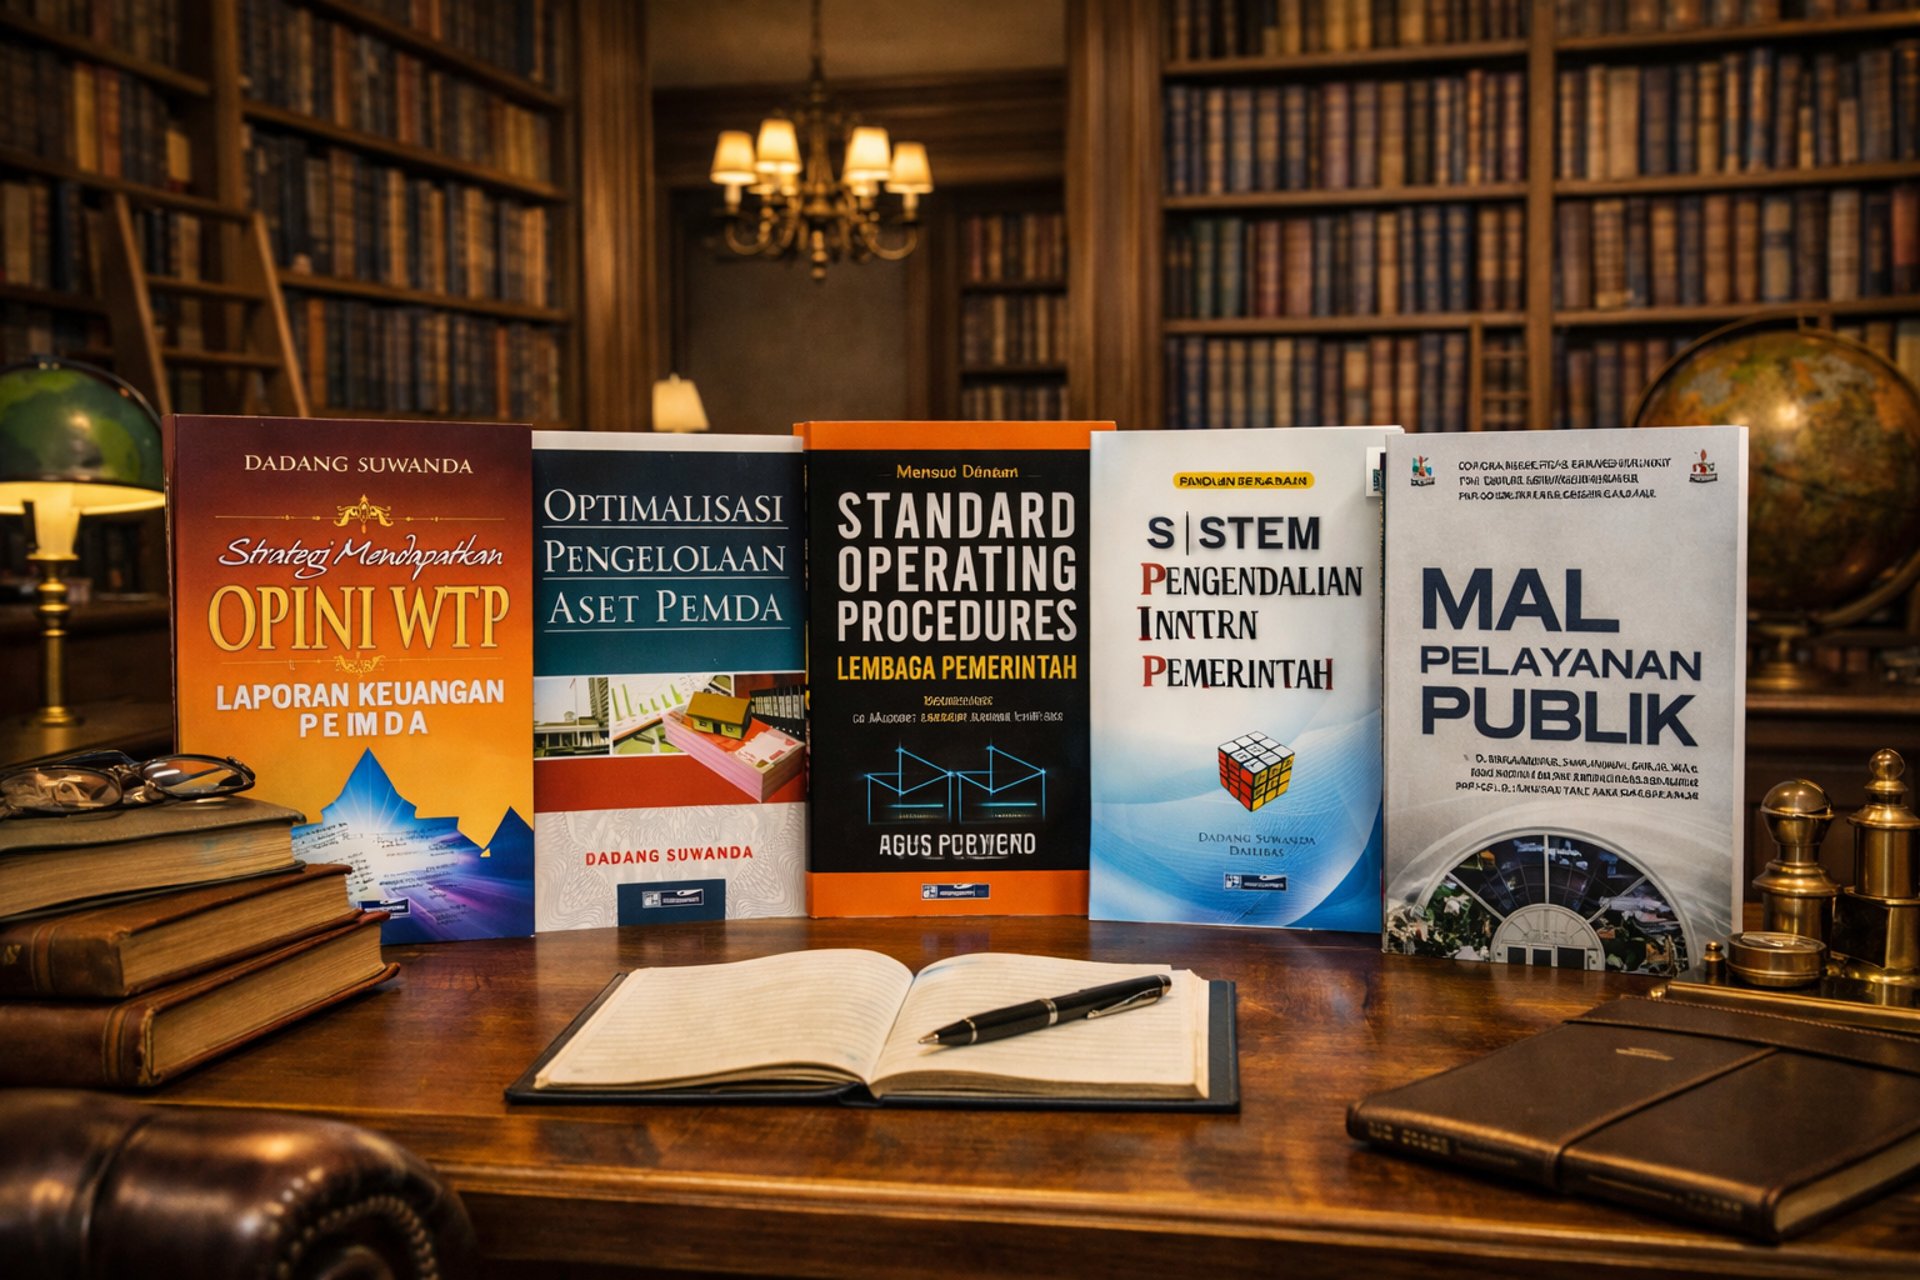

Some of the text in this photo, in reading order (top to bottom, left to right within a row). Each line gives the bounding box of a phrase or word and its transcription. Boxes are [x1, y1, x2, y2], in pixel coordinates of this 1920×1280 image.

[244, 454, 474, 475] DADANG SUWANDA
[544, 488, 784, 523] OPTIMALISASI
[837, 491, 1076, 540] STANDARD
[217, 533, 504, 581] Strategi Mendapatkan
[544, 539, 786, 573] PENGELOLAAN
[837, 545, 1077, 593] OPERATING
[1140, 562, 1364, 597] PENGENDALIAN
[547, 589, 783, 624] ASET PEMDA
[1422, 567, 1620, 633] MAL
[208, 584, 511, 652] OPINI WTP
[837, 599, 1078, 642] PROCEDURES
[837, 654, 1078, 681] LEMBAGA PEMERINTAH
[1142, 655, 1334, 691] PEMERINTAH
[1420, 645, 1702, 681] PELAYANAN
[216, 679, 505, 711] LAPORAN KEUANGAN
[1421, 685, 1699, 747] PUBLIK
[879, 834, 932, 856] AGUS
[1199, 832, 1251, 844] DADANG
[585, 846, 753, 866] DADANG SUWANDA
